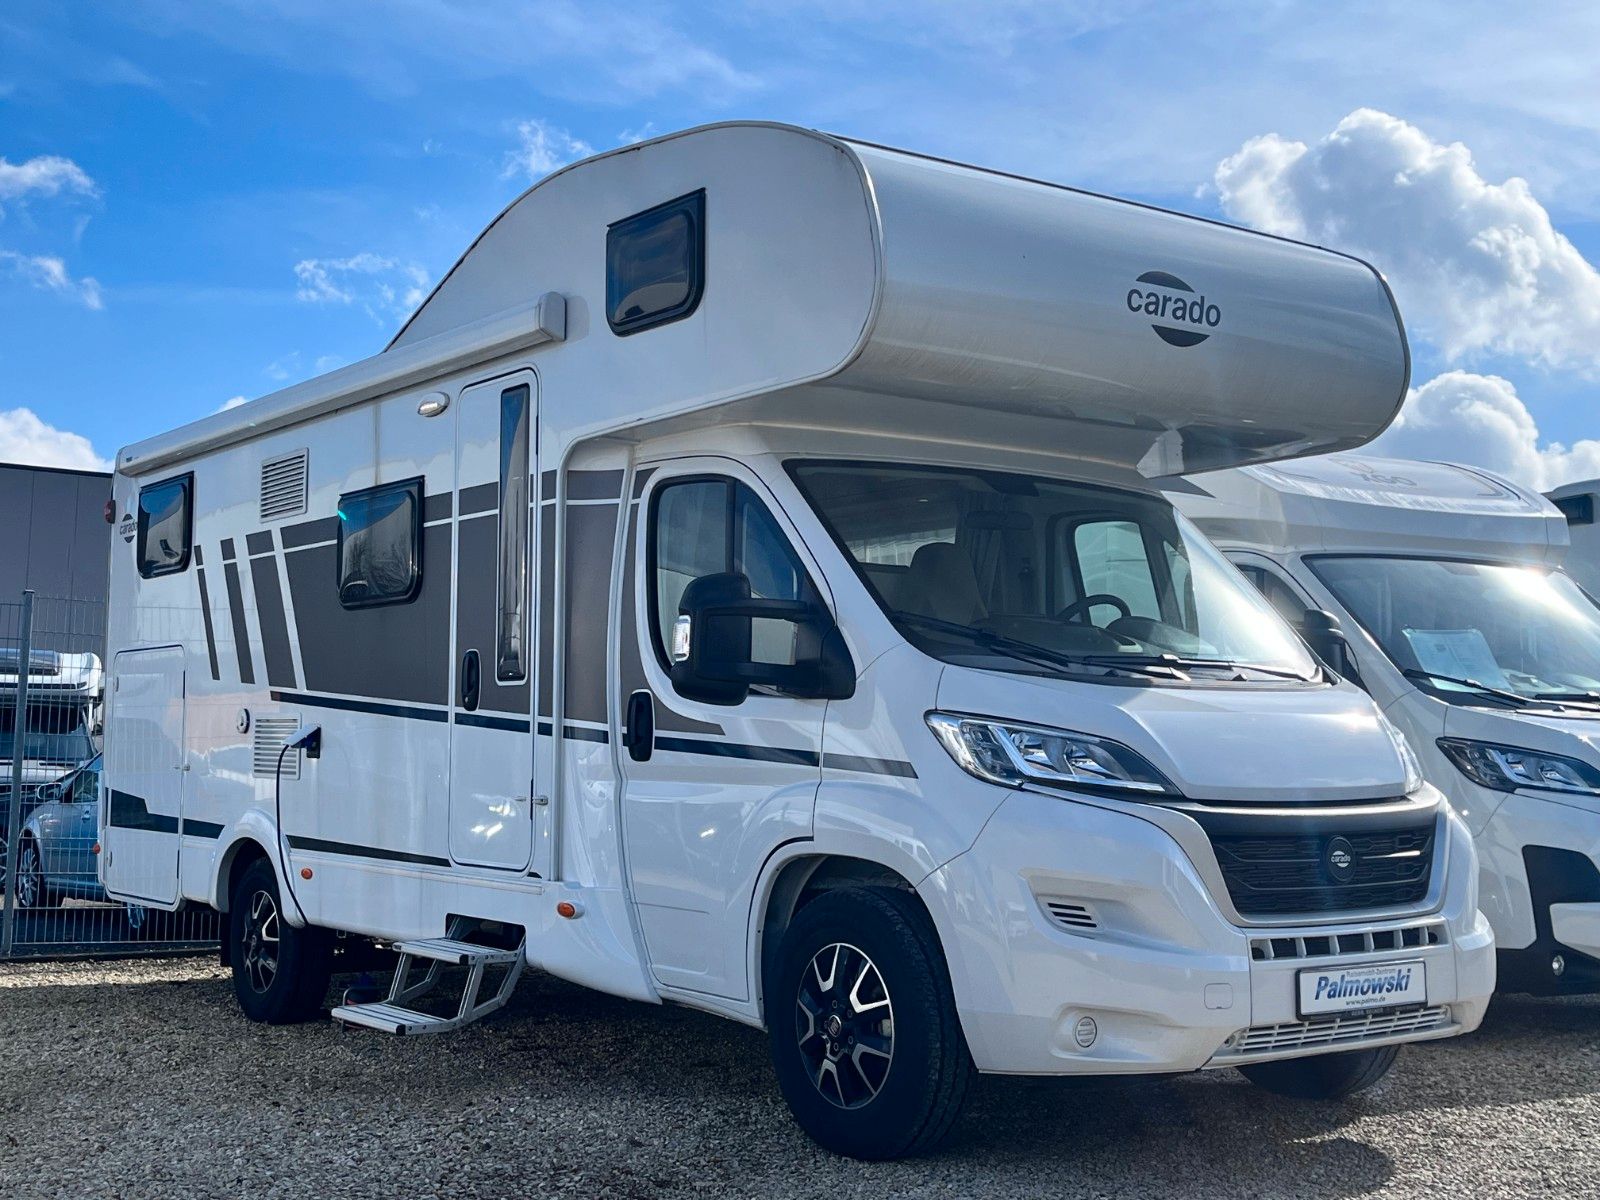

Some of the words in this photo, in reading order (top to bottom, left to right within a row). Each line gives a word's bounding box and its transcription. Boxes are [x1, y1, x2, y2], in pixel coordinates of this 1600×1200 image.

[1127, 289, 1221, 327] carado
[1331, 854, 1351, 863] carado
[1315, 968, 1411, 1000] Palmowski
